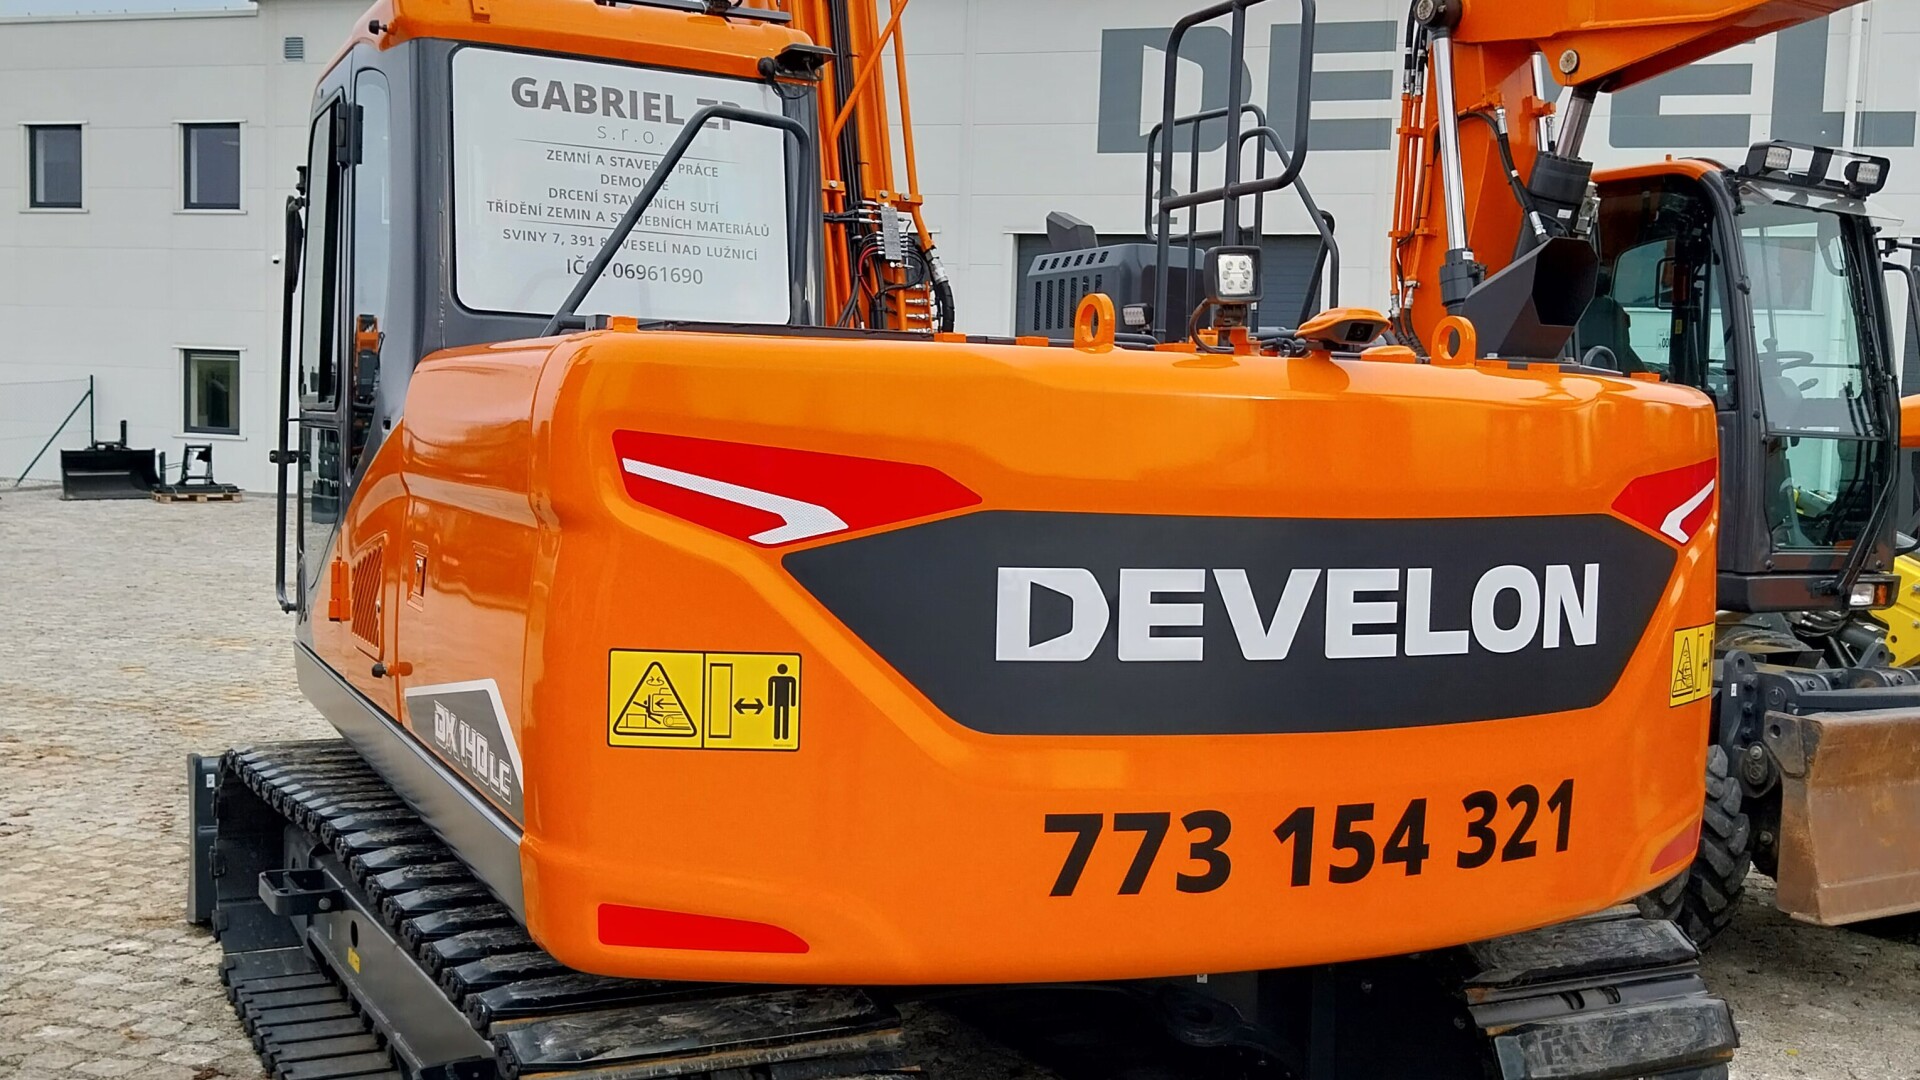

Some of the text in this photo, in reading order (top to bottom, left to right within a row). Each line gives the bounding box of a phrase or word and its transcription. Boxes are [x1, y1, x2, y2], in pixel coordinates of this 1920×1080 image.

[511, 76, 685, 126] GABRIEL
[546, 149, 719, 178] ZEMNÍ A STAVEB PRÁCE
[600, 173, 670, 191] DEMOLE
[548, 187, 720, 215] DRCENÍ STAVNÍCH SUTÍ
[486, 199, 770, 238] TŘÍDĚNÍ ZEMIN A STVEBNÍCH MATERIÁLŮ
[503, 228, 547, 243] SVINY
[552, 233, 565, 247] 7,
[570, 234, 595, 248] 391
[622, 239, 667, 254] VESELÍ
[672, 243, 702, 256] NAD
[706, 246, 758, 261] LUŽNICÍ
[612, 262, 703, 285] 06961690
[995, 563, 1600, 662] DEVELON
[1044, 778, 1575, 897] 773 154 321
